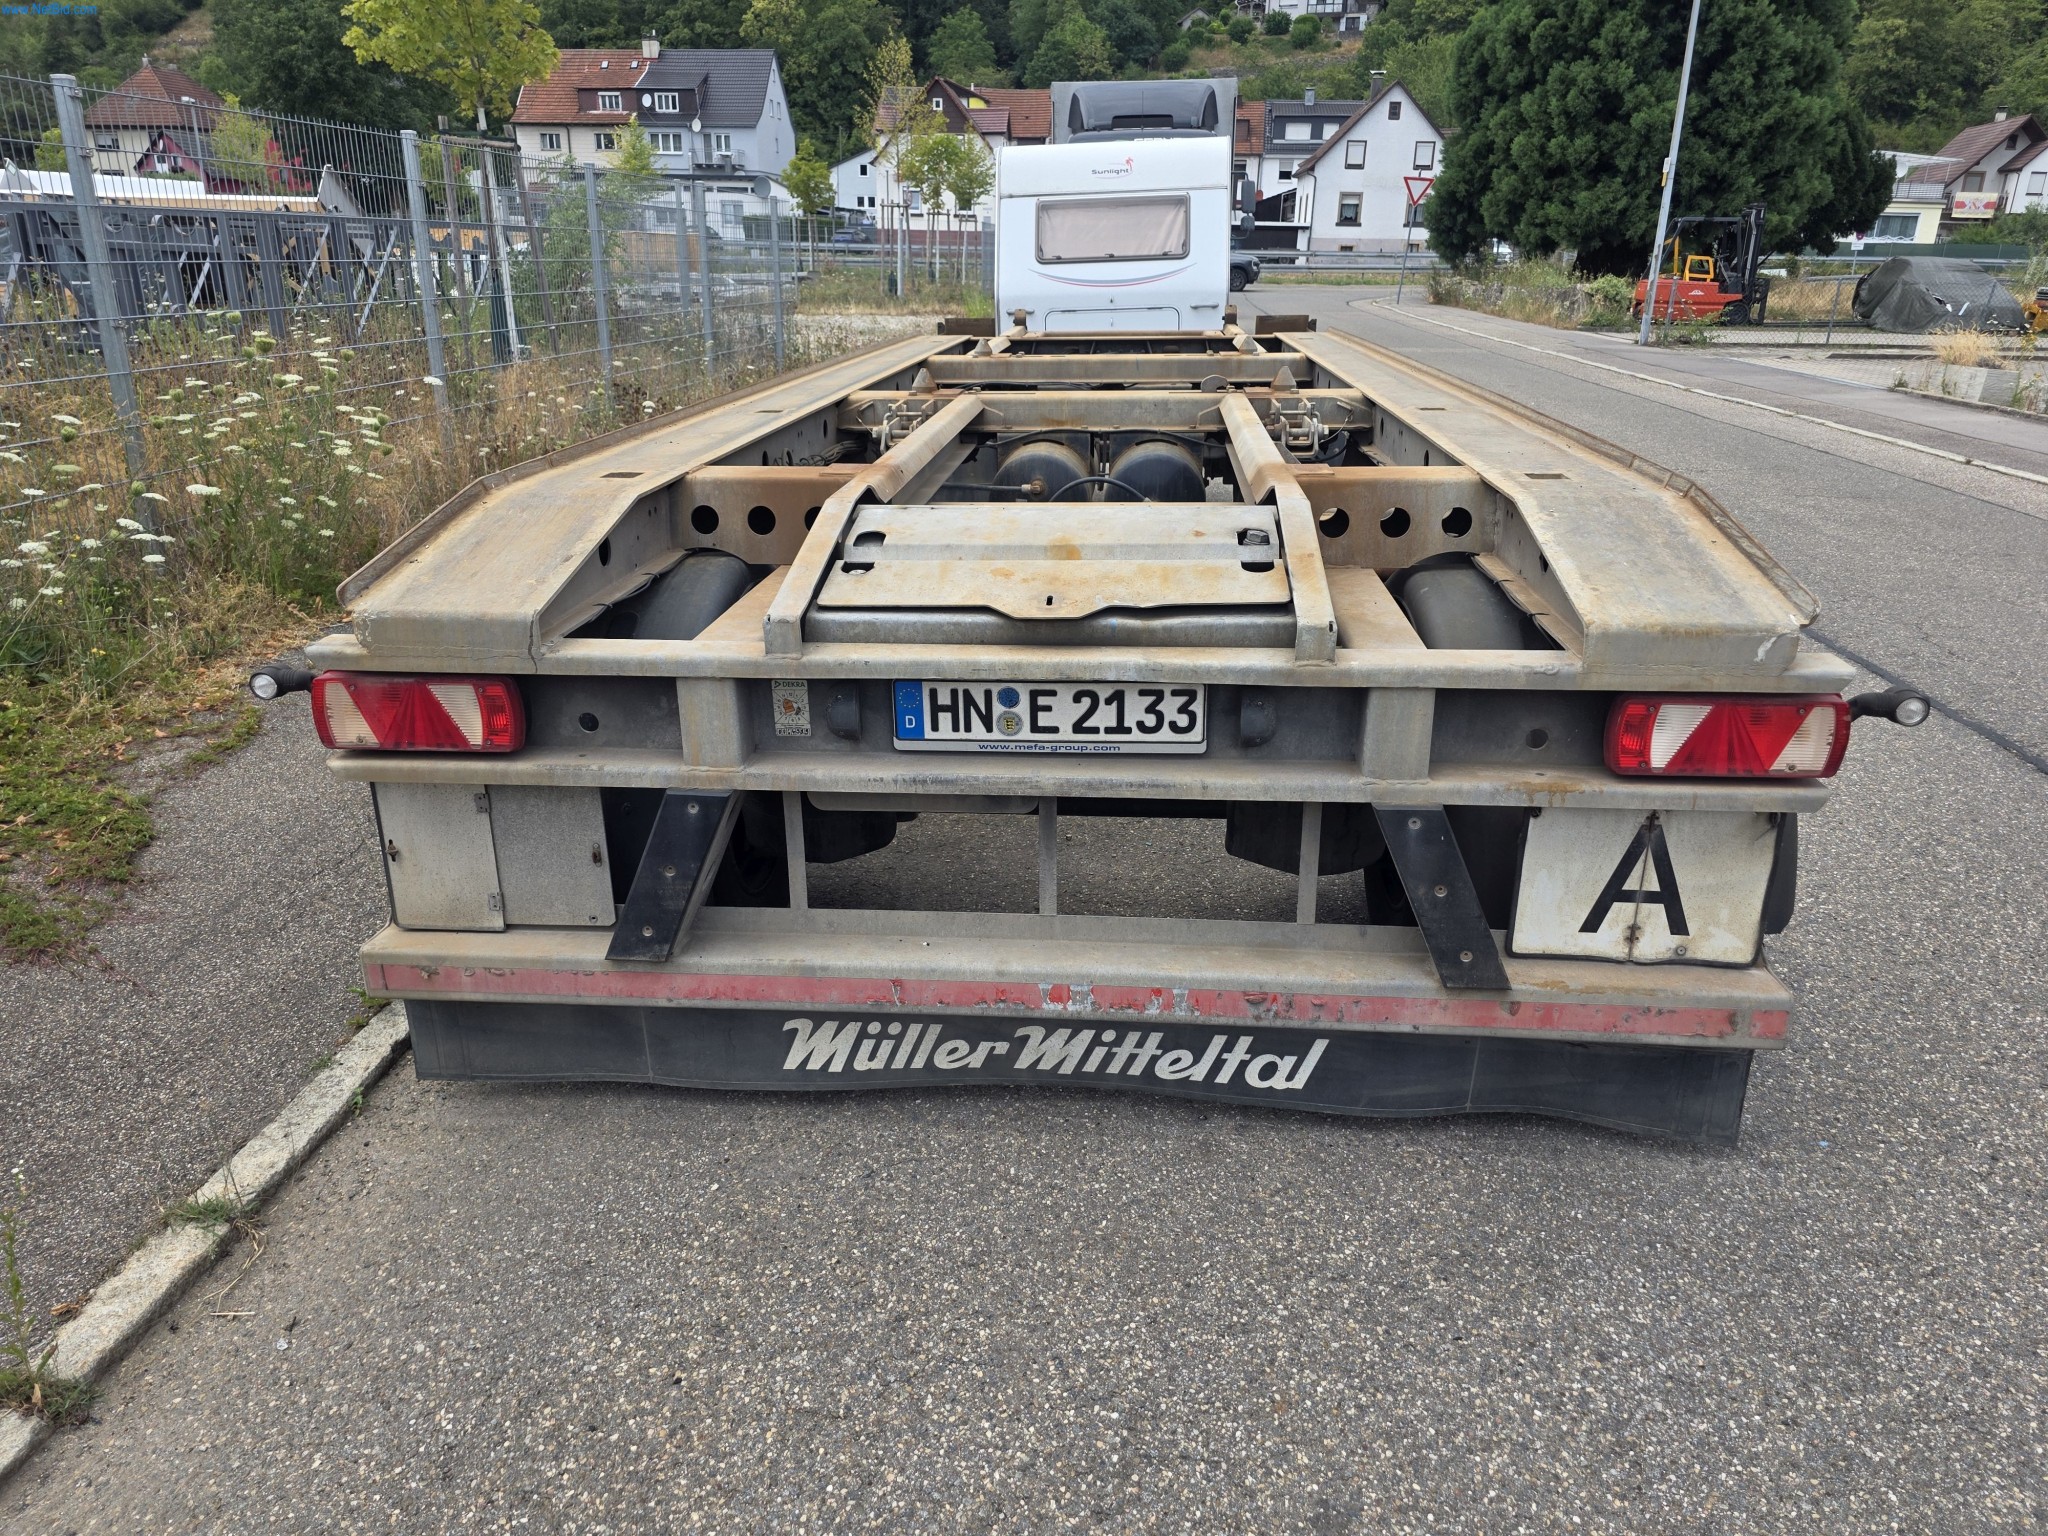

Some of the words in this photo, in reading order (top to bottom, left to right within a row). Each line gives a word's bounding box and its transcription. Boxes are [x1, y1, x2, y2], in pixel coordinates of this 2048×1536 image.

[905, 715, 916, 728] D
[929, 687, 993, 733] HN
[1029, 688, 1060, 734] E
[1071, 688, 1198, 735] 2133
[978, 742, 1121, 753] www.mefa-group.com
[1578, 824, 1690, 936] A
[782, 1017, 1009, 1073] Müller
[1014, 1024, 1330, 1090] Mitteltal
